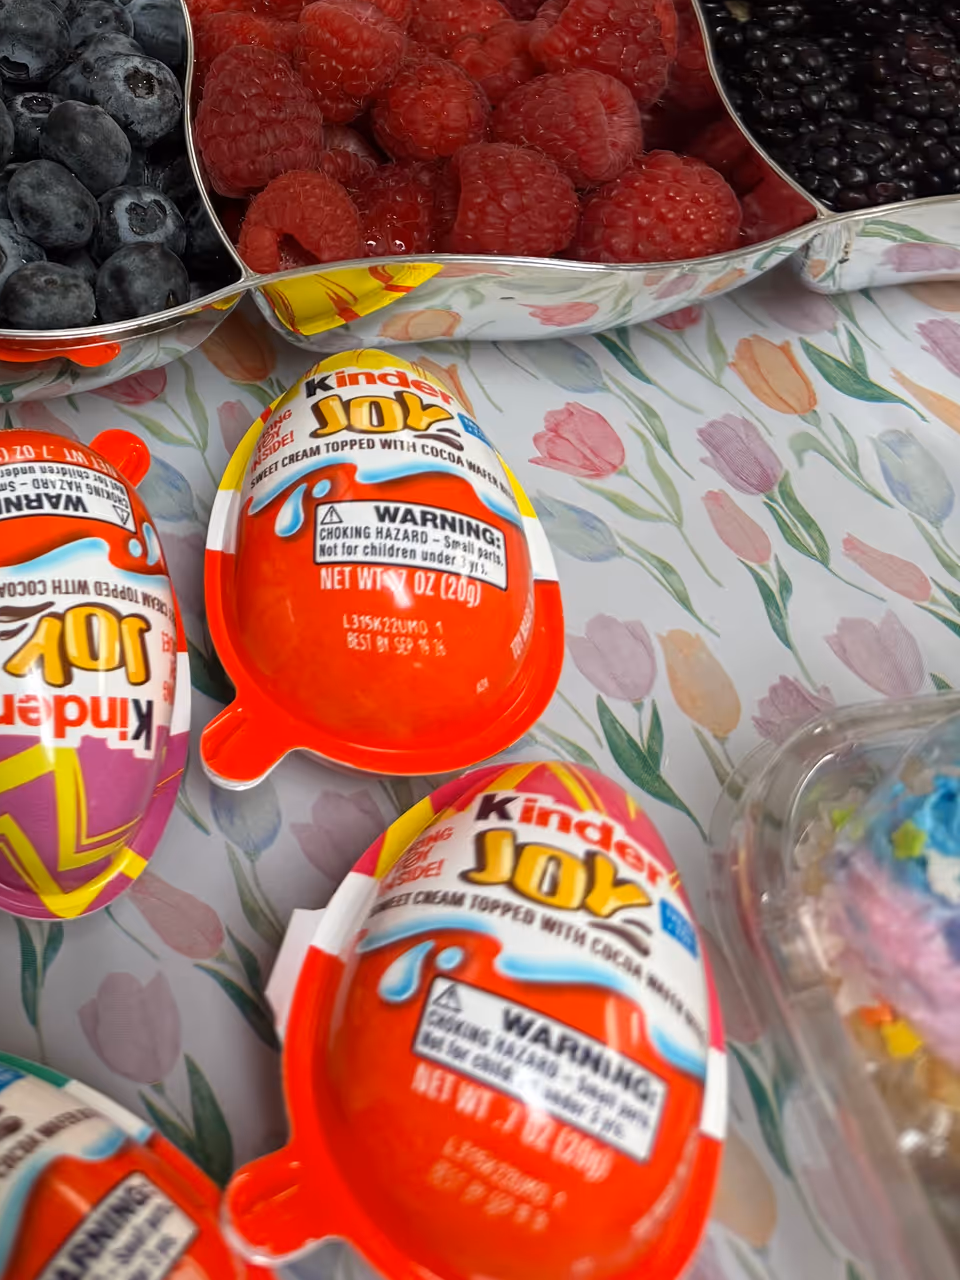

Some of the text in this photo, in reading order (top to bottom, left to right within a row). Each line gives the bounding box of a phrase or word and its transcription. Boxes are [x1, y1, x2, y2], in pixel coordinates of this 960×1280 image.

[305, 370, 454, 405] Kinder
[309, 390, 455, 438] JOY
[12, 445, 35, 459] OZ
[63, 448, 88, 465] WT
[250, 438, 464, 489] SWEET CREAM TOPPED WITH COCOA
[0, 466, 36, 479] under
[32, 478, 82, 492] HAZARD
[39, 466, 90, 480] children
[93, 475, 109, 488] for
[86, 483, 129, 510] CHOKING
[320, 525, 475, 554] CHOKING HAZARD Small
[374, 505, 501, 550] WARNING:
[319, 543, 338, 557] Not
[342, 542, 358, 556] for
[362, 543, 417, 560] children
[421, 550, 456, 566] under
[52, 579, 90, 596] WITH
[93, 580, 139, 601] TOPPED
[320, 566, 482, 608] NET WT OZ (20g)
[2, 601, 152, 688] JOY
[346, 631, 371, 650] BEST
[474, 792, 663, 887] Kinder
[458, 827, 653, 918] JOY
[413, 890, 642, 977] CREAM TOPPED WITH COCOA
[502, 1007, 658, 1106] WARNING:
[411, 1061, 457, 1103] NET
[454, 1081, 495, 1123] WT
